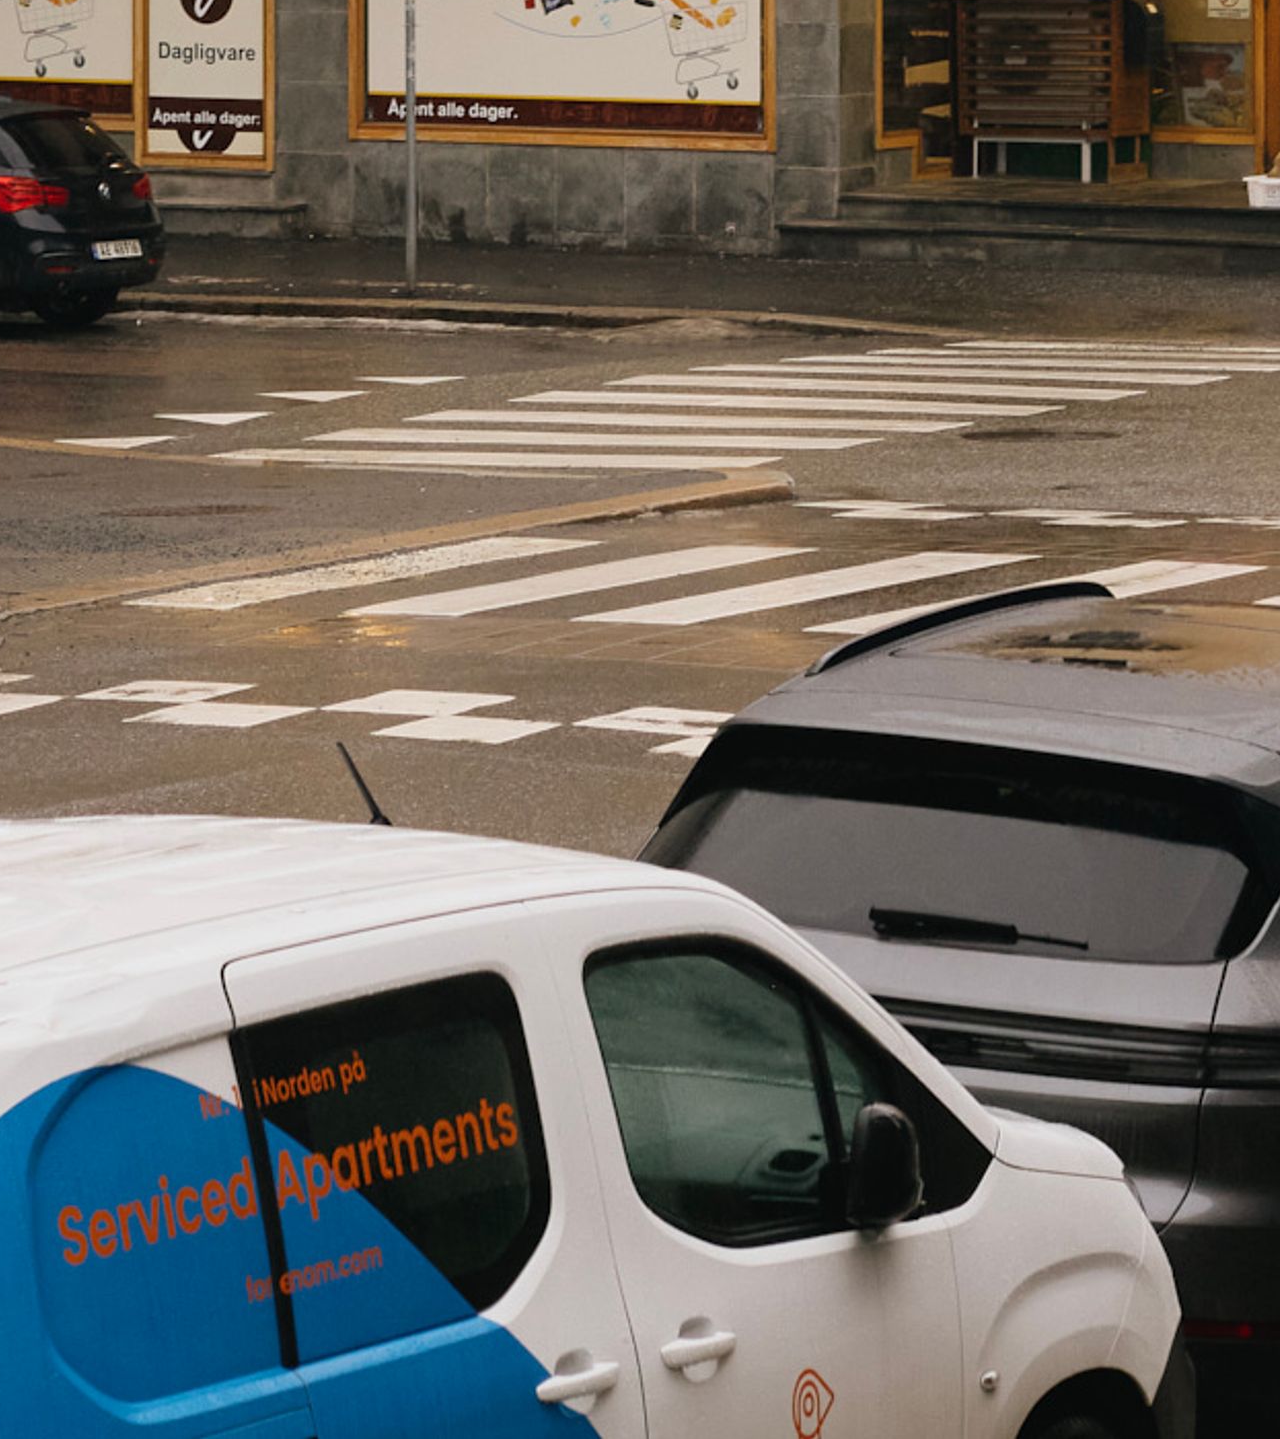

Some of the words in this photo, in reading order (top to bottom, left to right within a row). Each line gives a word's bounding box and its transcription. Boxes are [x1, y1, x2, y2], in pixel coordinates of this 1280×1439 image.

[158, 41, 256, 64] Dagligvare
[194, 110, 216, 125] alle
[437, 101, 465, 117] alle
[252, 1077, 261, 1108] i
[261, 1066, 336, 1104] Norden
[338, 1050, 367, 1095] på
[57, 1155, 258, 1266] Serviced
[276, 1098, 520, 1221] Apartments
